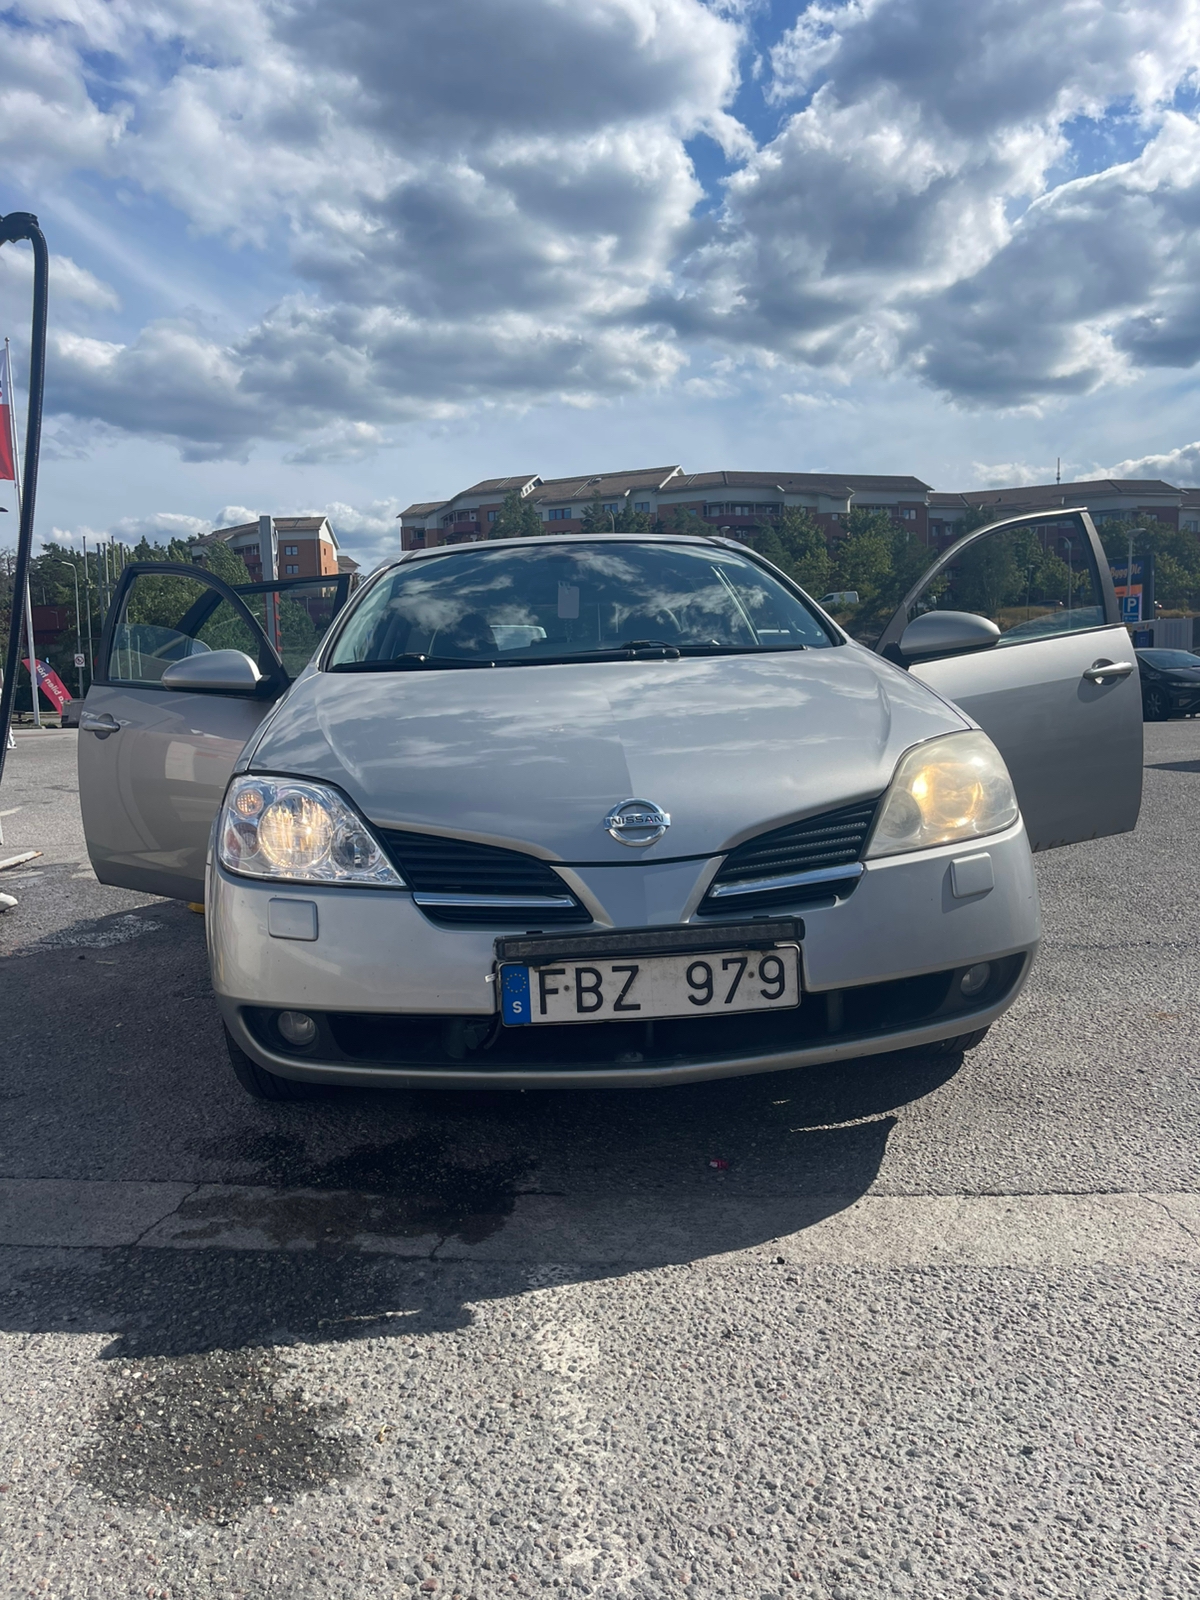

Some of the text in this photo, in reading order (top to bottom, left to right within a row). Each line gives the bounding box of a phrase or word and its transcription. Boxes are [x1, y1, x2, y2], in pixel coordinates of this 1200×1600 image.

[1127, 598, 1137, 612] P
[611, 815, 664, 825] NISSAN
[537, 955, 786, 1015] FBZ 979
[512, 1001, 523, 1013] S
